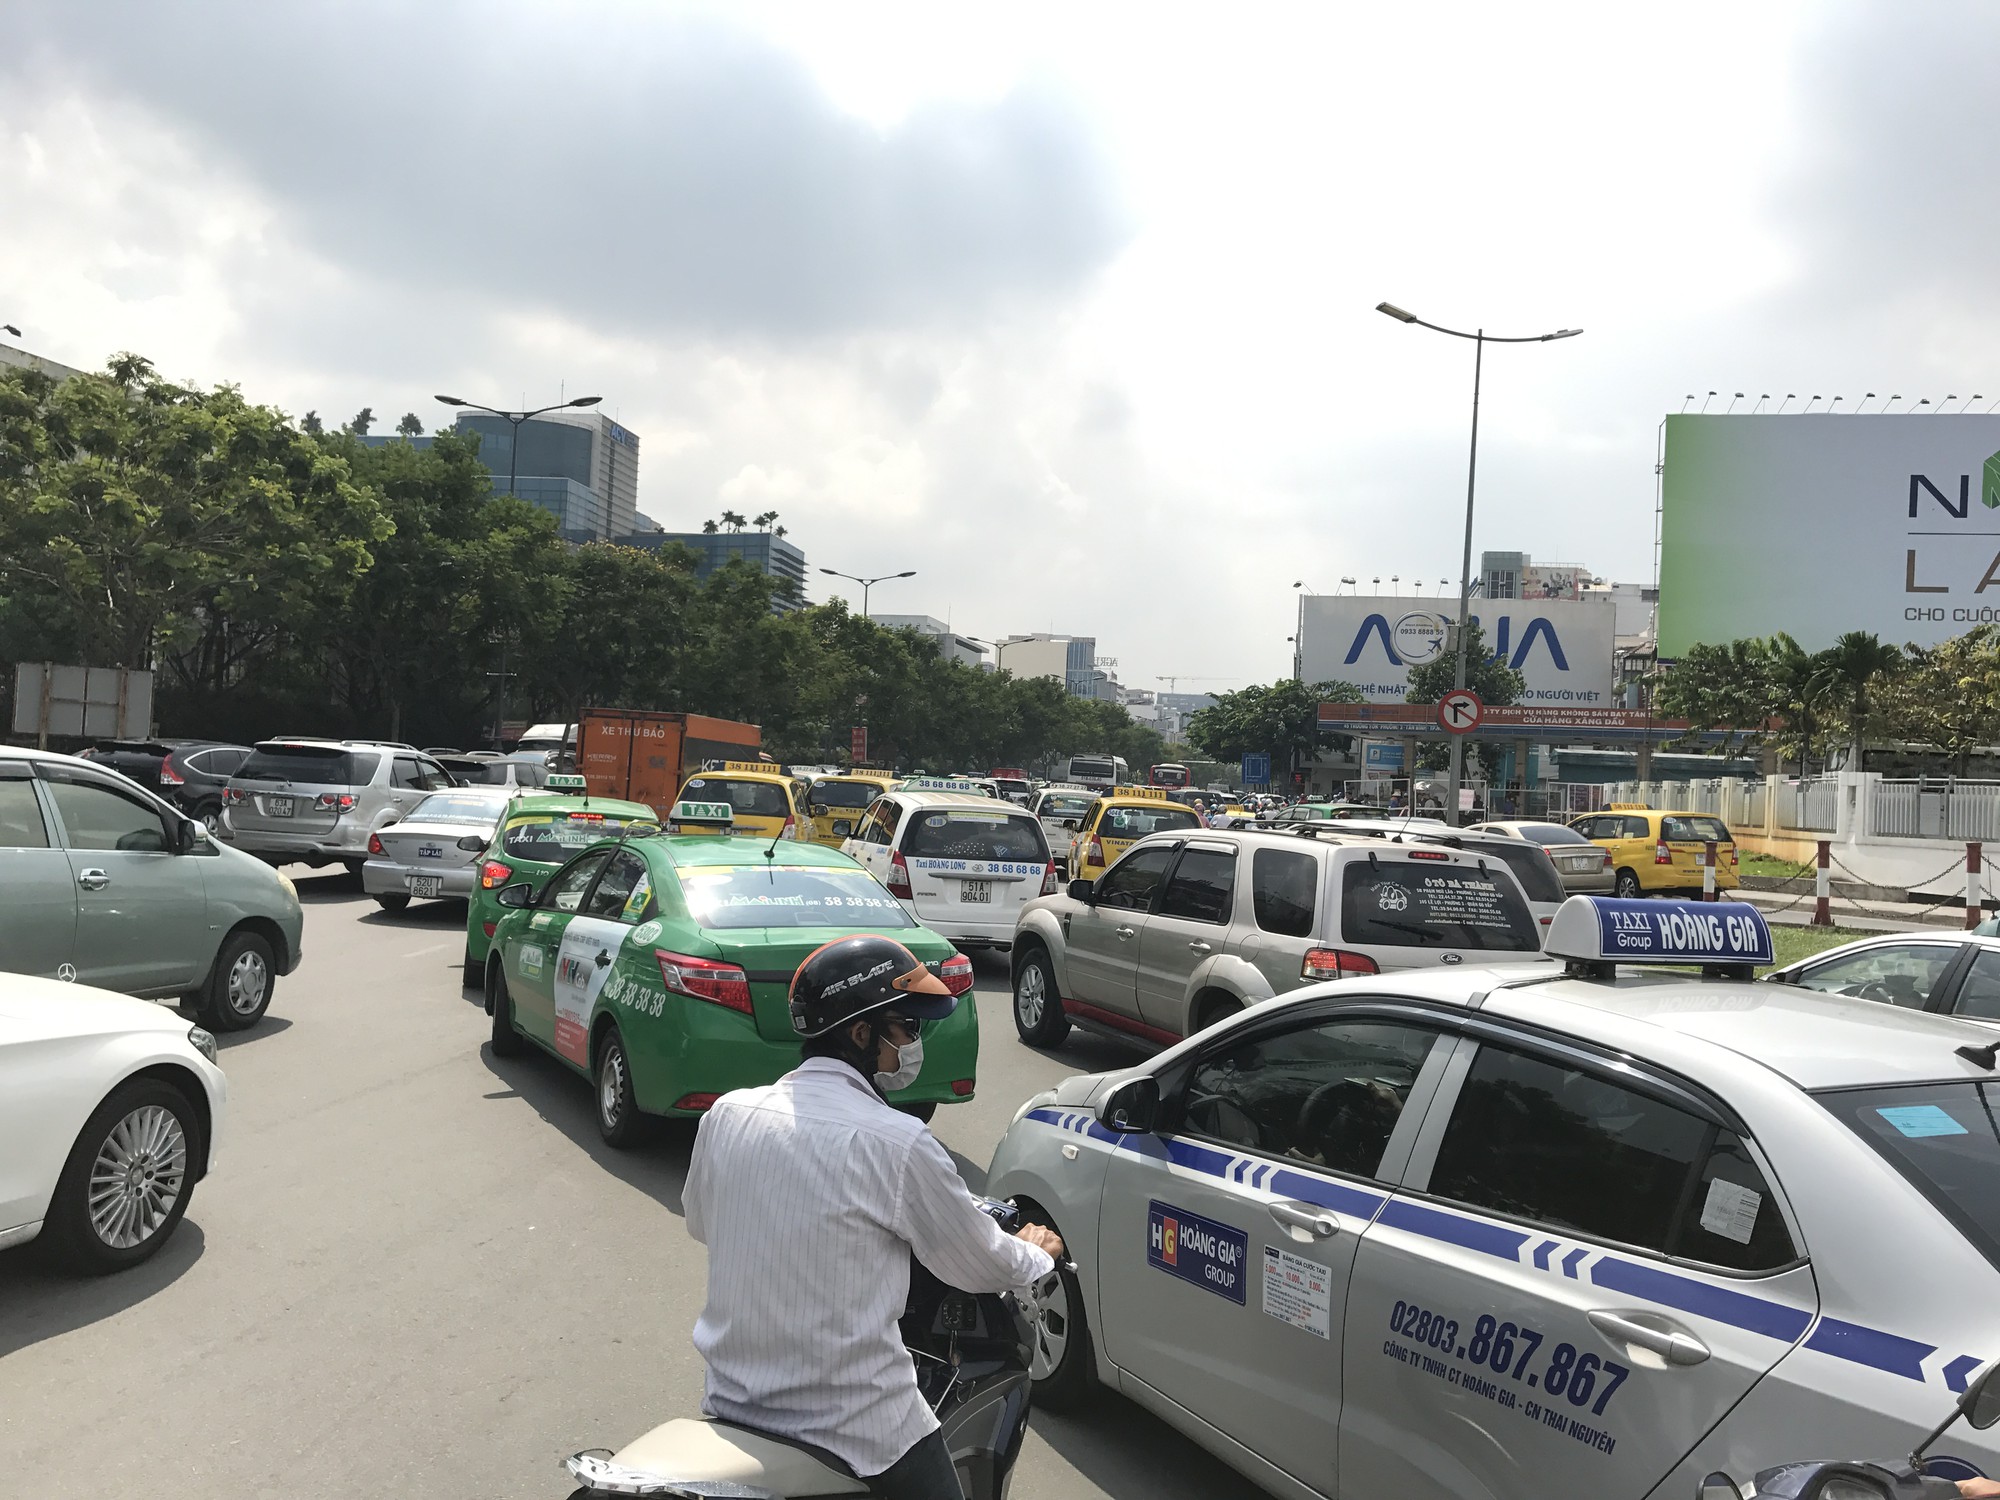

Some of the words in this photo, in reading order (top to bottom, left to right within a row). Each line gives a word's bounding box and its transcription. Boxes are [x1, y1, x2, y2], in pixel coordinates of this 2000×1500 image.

[1904, 607, 1945, 621] CHO
[1343, 613, 1570, 671] AUA
[1377, 683, 1408, 697] NHẬT
[1517, 690, 1534, 699] HO
[1536, 689, 1573, 701] NGƯỜI
[1575, 690, 1600, 704] VIỆT
[1522, 714, 1543, 724] CỬA
[1544, 715, 1572, 724] HÀNG
[1574, 717, 1603, 726] XĂNG
[1560, 709, 1590, 717] KHÔNG
[601, 726, 615, 736] XE
[617, 727, 641, 737] THƯ
[643, 727, 665, 739] BÁO
[702, 758, 726, 772] KE
[728, 762, 741, 770] 38
[743, 763, 759, 772] 111
[761, 764, 777, 773] 111
[932, 780, 943, 788] 68
[946, 781, 957, 789] 68
[959, 782, 970, 790] 68
[1117, 788, 1130, 796] 38
[1132, 789, 1146, 798] 111
[1148, 791, 1163, 799] 111
[509, 835, 533, 844] TAXI
[915, 859, 928, 868] Taxi
[928, 858, 949, 870] HOÀNG
[950, 861, 967, 871] LONG
[987, 863, 1000, 873] 38
[1002, 864, 1013, 873] 68
[1016, 865, 1028, 874] 68
[1029, 866, 1041, 875] 68
[416, 877, 433, 887] 52U
[968, 881, 984, 892] 51A
[413, 886, 433, 896] 8621
[962, 891, 989, 902] 904.01
[824, 896, 842, 906] 38
[845, 897, 864, 907] 38
[864, 897, 882, 907] 38
[883, 898, 901, 909] 38
[1609, 911, 1652, 930] TAXI
[1656, 907, 1724, 951] HOÀNG
[1726, 915, 1759, 952] GIA
[1617, 933, 1652, 950] Group
[819, 979, 848, 999] AIR
[846, 959, 895, 987] BLADE
[608, 977, 626, 1001] 38
[620, 982, 639, 1007] 38
[634, 987, 652, 1012] 38
[649, 992, 666, 1018] 38
[1179, 1223, 1216, 1258] HOÀNG
[1217, 1240, 1237, 1267] GIA
[1204, 1263, 1235, 1289] GROUP
[1389, 1300, 1630, 1416] 02803.867.867
[1383, 1340, 1407, 1363] CÔNG
[1409, 1350, 1421, 1367] TY
[1422, 1355, 1447, 1379] TNHH
[1447, 1367, 1461, 1384] CT
[1461, 1374, 1496, 1400] HOÀNG
[1497, 1388, 1516, 1410] GIA
[1524, 1400, 1540, 1421] CN
[1569, 1420, 1616, 1455] NGUYÊN
